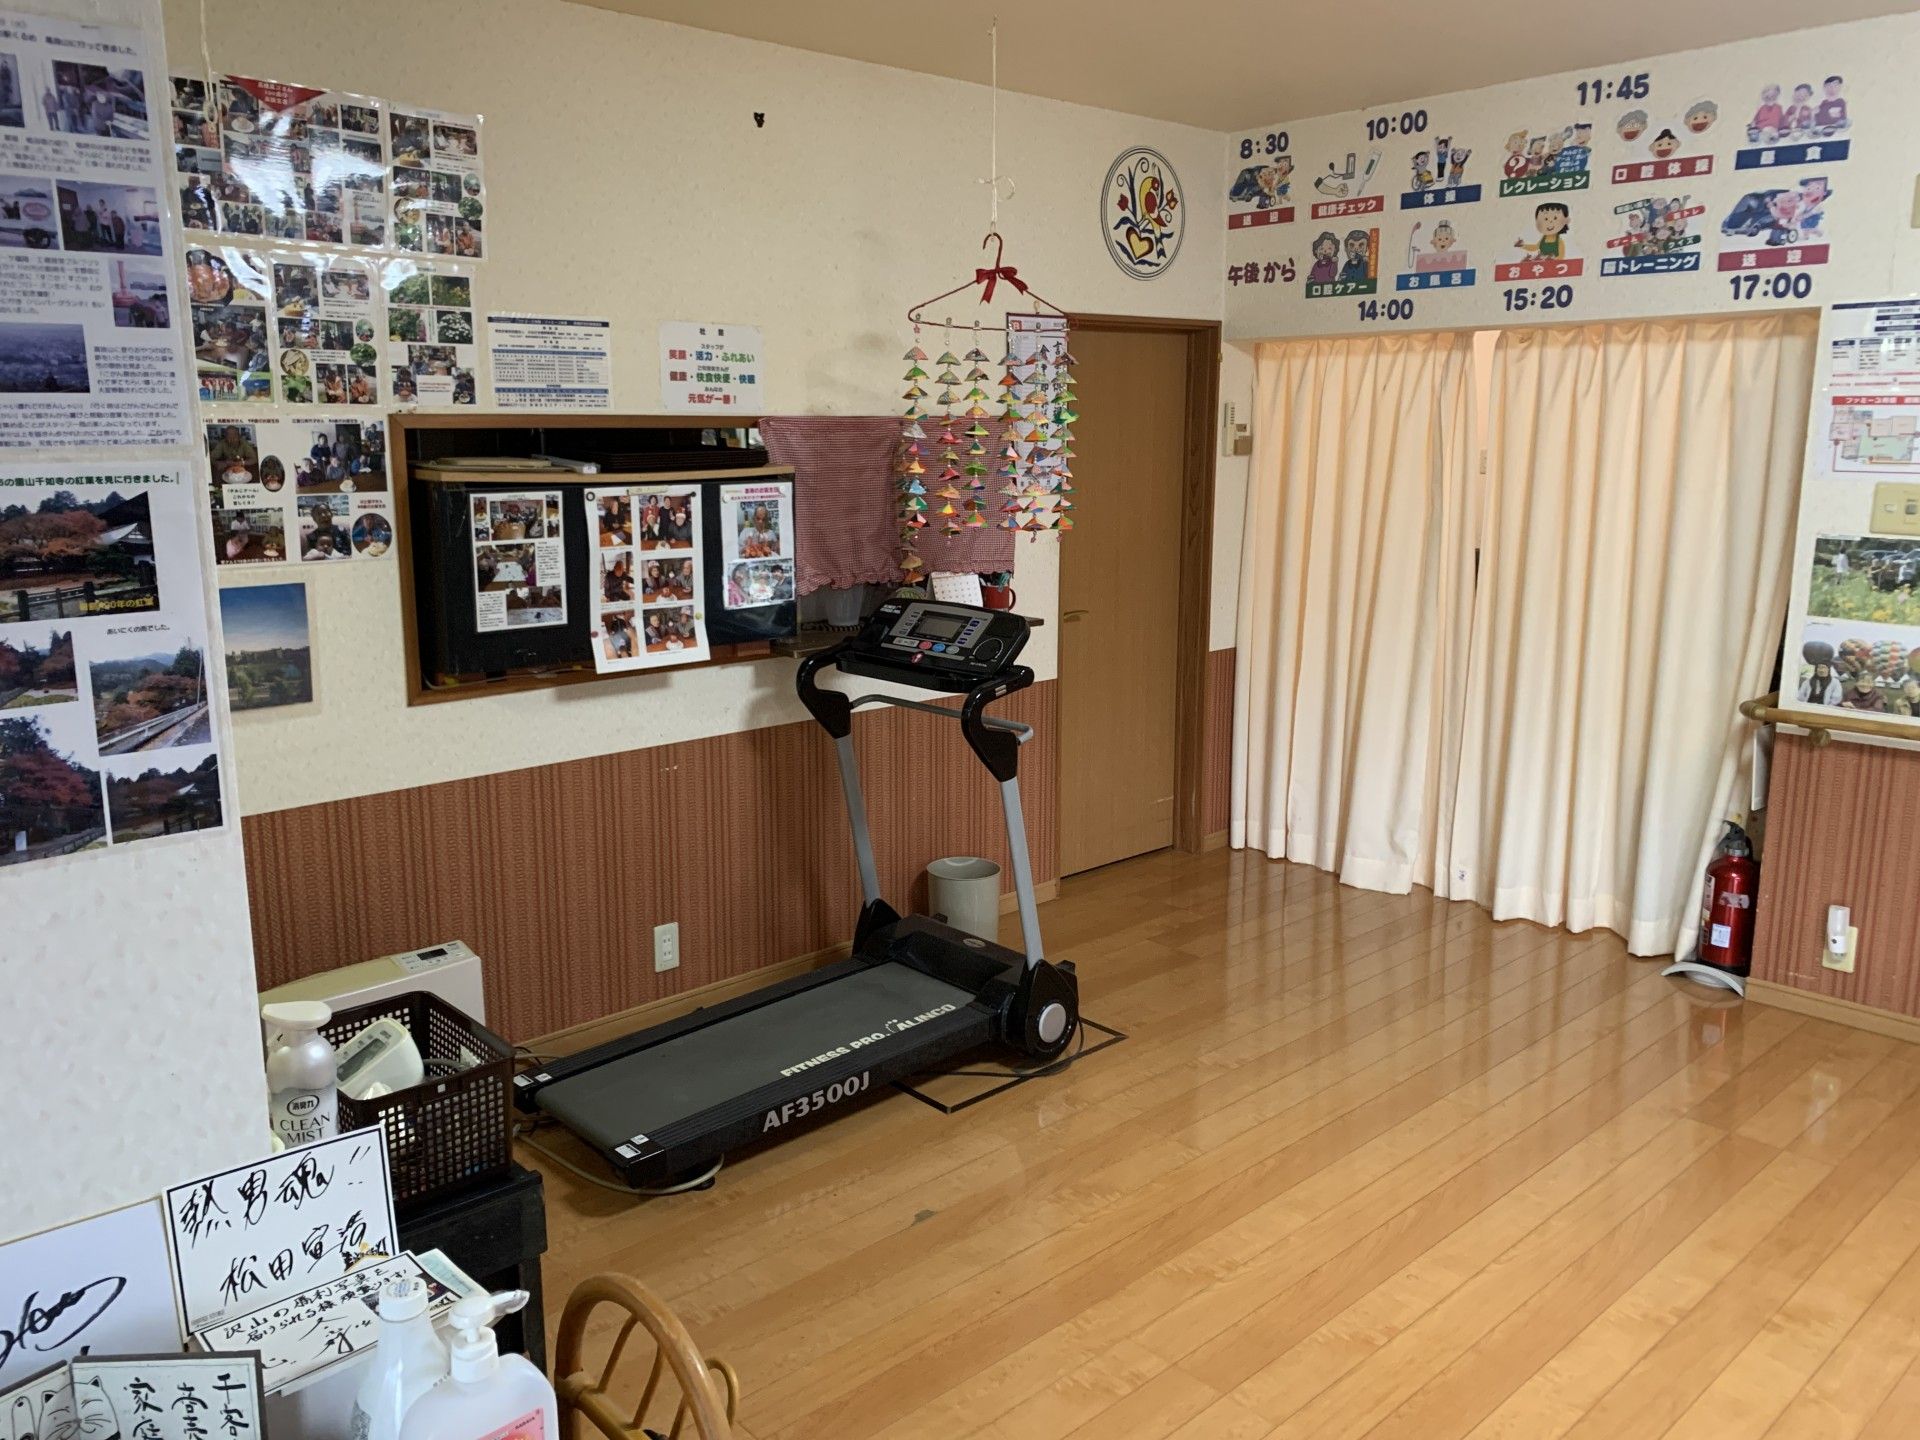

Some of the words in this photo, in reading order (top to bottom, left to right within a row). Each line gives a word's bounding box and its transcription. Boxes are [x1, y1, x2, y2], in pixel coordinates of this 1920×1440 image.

[1577, 73, 1650, 105] 11:45
[1366, 109, 1428, 140] 10:00
[1240, 131, 1289, 159] 8:30
[1503, 175, 1587, 195] レクレーション
[1318, 199, 1377, 216] 健康チェック
[1508, 263, 1569, 280] おやつ
[1602, 254, 1699, 275] 脳トレーニング
[1312, 281, 1368, 295] 口腔ケアー
[1408, 273, 1462, 288] お風呂
[1730, 272, 1812, 300] 17:00
[1503, 284, 1573, 311] 15:20
[1358, 299, 1414, 321] 14:00
[780, 1046, 851, 1077] FITNESS
[896, 1003, 957, 1031] ALINCO
[762, 1070, 871, 1133] AF3500J
[280, 1111, 331, 1131] CLEAN
[287, 1128, 323, 1144] MIST
